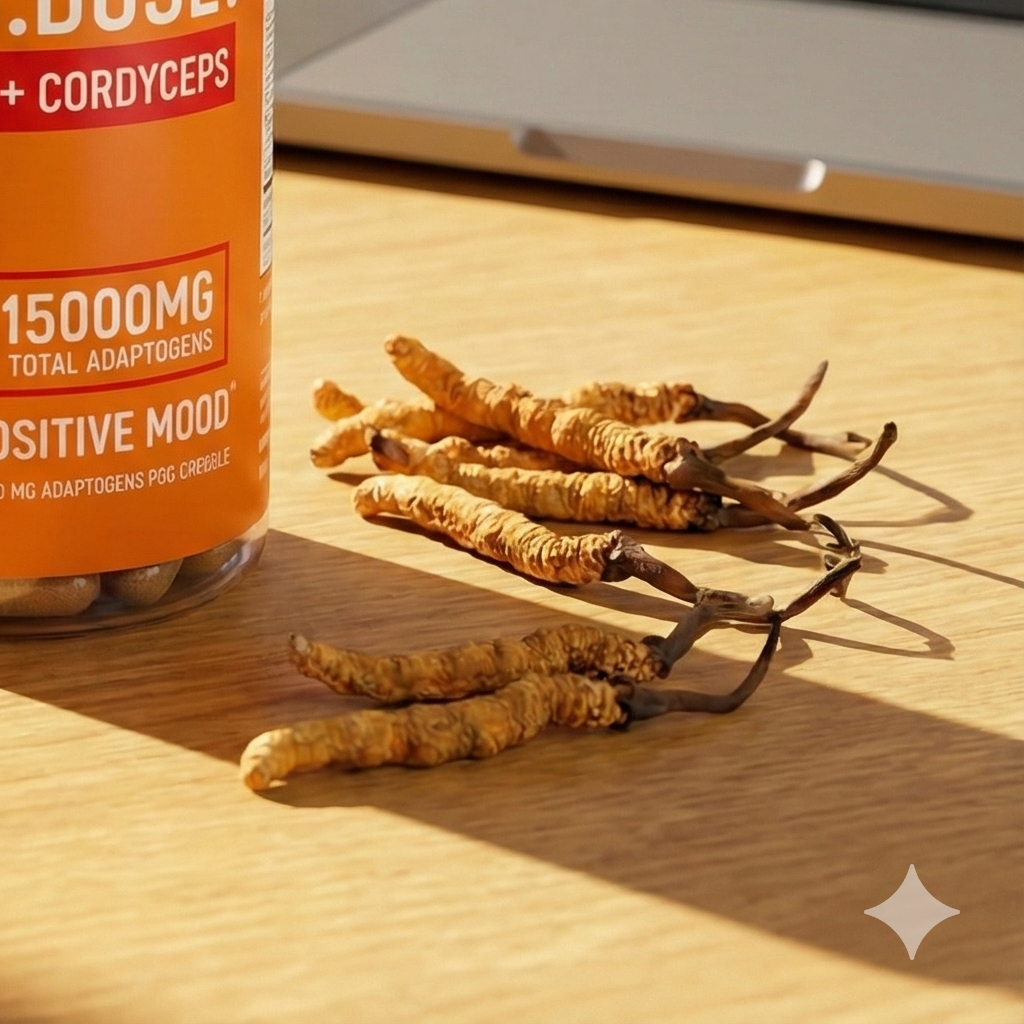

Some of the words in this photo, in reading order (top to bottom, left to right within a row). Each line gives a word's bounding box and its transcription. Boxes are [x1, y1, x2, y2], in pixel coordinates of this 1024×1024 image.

[0, 79, 25, 106] +
[39, 47, 229, 114] CORDYCEPS
[2, 270, 214, 344] 15000MG
[9, 353, 78, 376] TOTAL
[87, 328, 213, 371] ADAPTOGENS
[11, 482, 36, 500] MG
[41, 470, 144, 499] ADAPTOGENS
